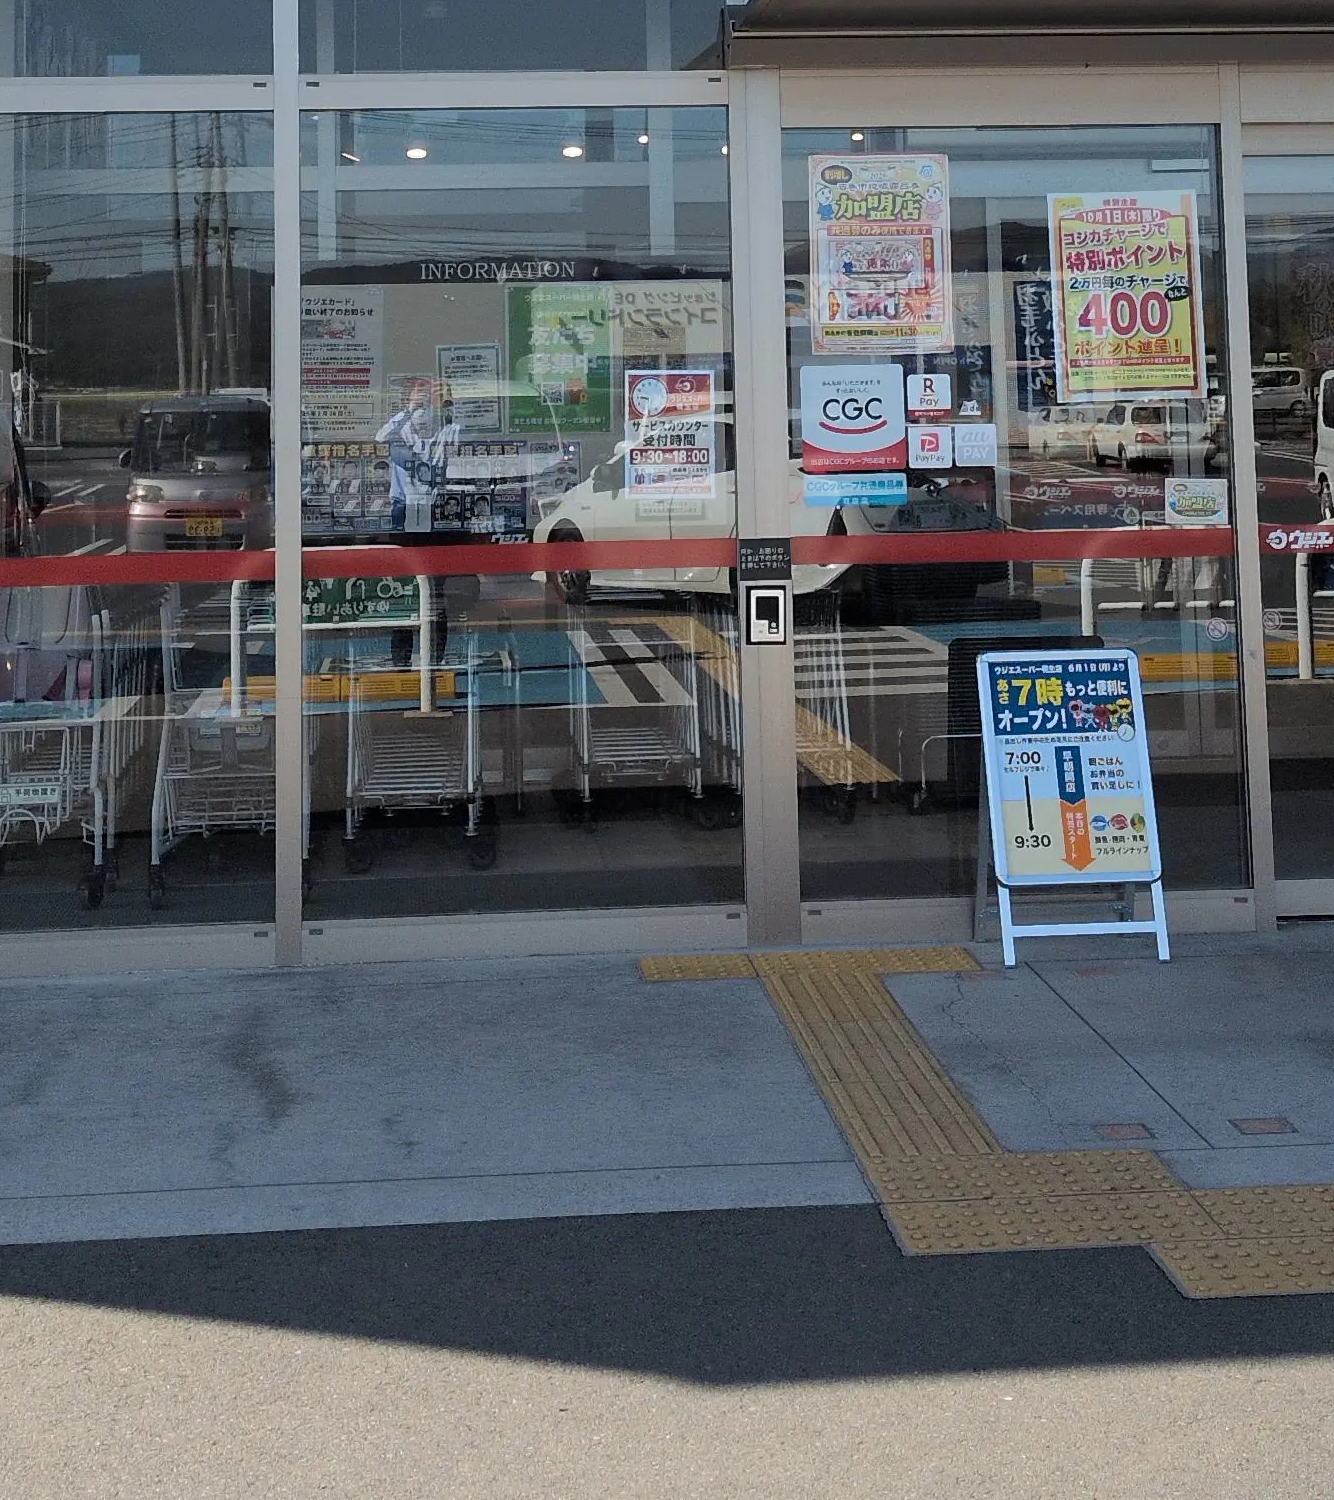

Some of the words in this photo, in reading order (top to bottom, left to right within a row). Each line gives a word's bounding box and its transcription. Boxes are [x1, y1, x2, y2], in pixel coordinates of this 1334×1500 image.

[835, 192, 924, 221] 加盟店
[1063, 221, 1167, 247] コジカチャージで
[1066, 240, 1186, 275] 特別ポイント
[420, 261, 576, 280] INFORMATION
[1078, 291, 1169, 338] 400
[924, 377, 935, 394] R
[823, 397, 883, 421] CGC
[920, 397, 939, 408] Pay
[632, 420, 709, 432] サービスカウンター
[643, 434, 696, 447] 受付時間
[915, 455, 945, 463] PayPay
[963, 447, 989, 459] PAY
[1289, 530, 1334, 549] ウジエ
[996, 679, 1009, 704] あさ
[1011, 677, 1064, 706] 7時
[1065, 680, 1128, 697] もっと便利に
[997, 707, 1068, 731] オープン!
[1005, 751, 1041, 764] 7:00
[1090, 769, 1125, 778] お弁当の
[1014, 835, 1052, 849] 9:30
[1096, 847, 1150, 856] フルラインナップ
